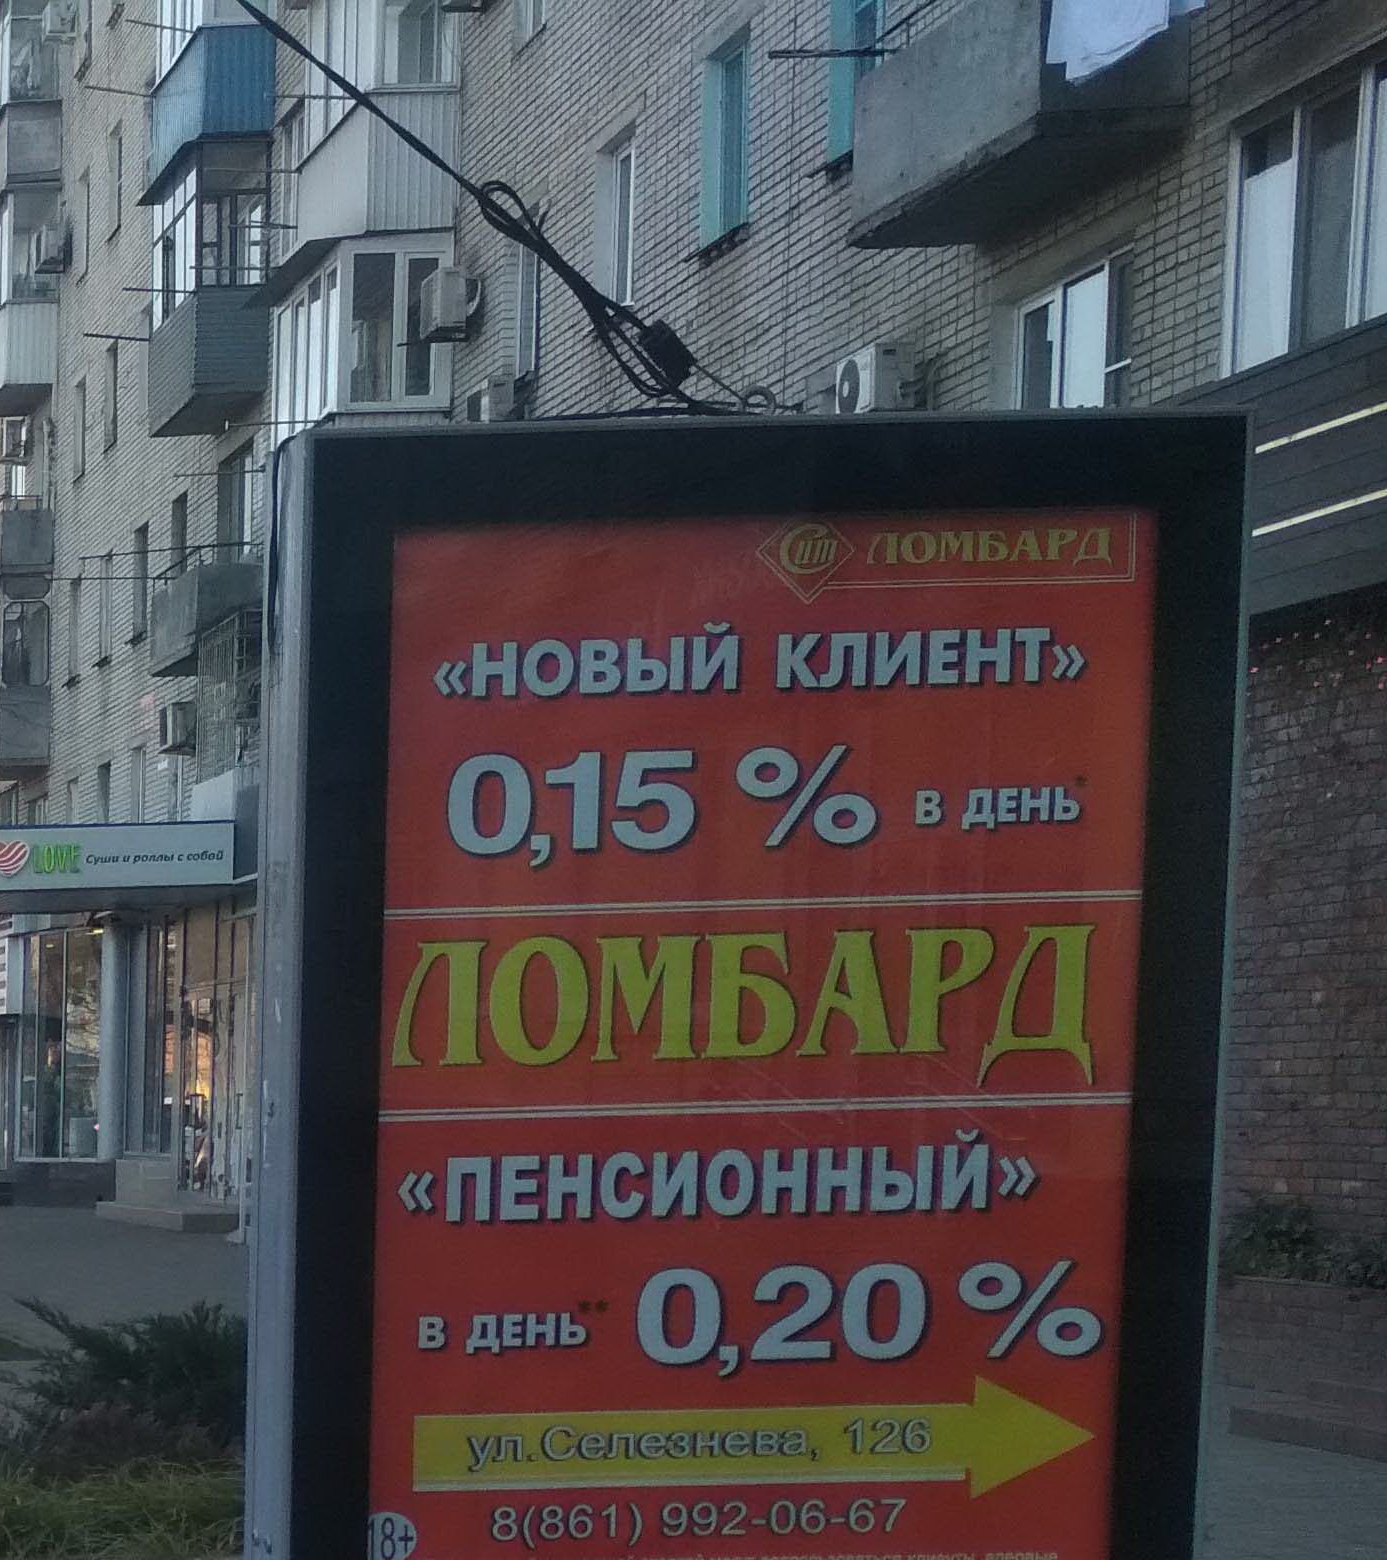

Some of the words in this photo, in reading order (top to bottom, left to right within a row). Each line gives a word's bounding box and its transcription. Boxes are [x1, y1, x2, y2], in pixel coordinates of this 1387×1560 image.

[866, 527, 1114, 567] ЛОМБАРД
[433, 622, 740, 698] «НОВЫЙ
[775, 626, 1085, 689] КЛИЕНТ»
[446, 750, 697, 866] 0,15
[33, 844, 80, 874] LOVE
[86, 853, 119, 866] Суши
[122, 855, 131, 863] и
[133, 853, 174, 865] роллы
[177, 853, 183, 862] с
[186, 849, 224, 862] собой
[391, 925, 1096, 1087] ЛОМБАРД
[398, 1129, 1037, 1224] «ПЕНСИОННЫЙ»
[636, 1262, 929, 1377] 0,20
[843, 1418, 931, 1455] 126
[367, 1517, 415, 1560] 18+
[490, 1500, 643, 1549] 8(861)
[661, 1497, 907, 1538] 992-06-67
